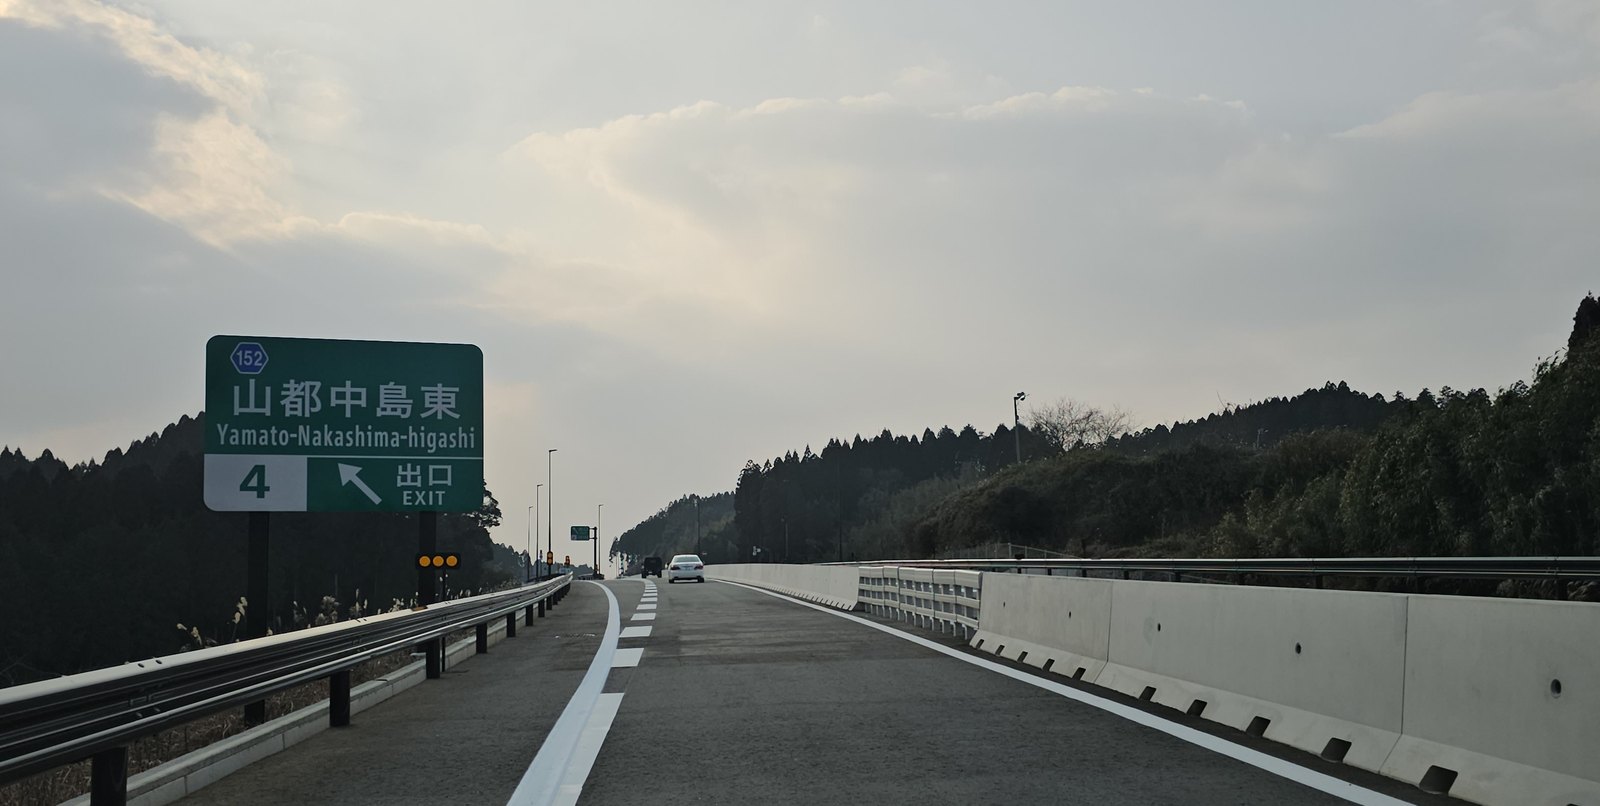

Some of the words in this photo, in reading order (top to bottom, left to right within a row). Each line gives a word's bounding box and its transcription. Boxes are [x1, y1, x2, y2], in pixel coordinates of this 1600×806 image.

[236, 351, 263, 367] 152
[233, 378, 461, 420] 山都中島東
[217, 423, 475, 453] Yamato-Nakashima-higashi
[239, 464, 270, 499] 4
[397, 463, 452, 487] 出口
[403, 491, 446, 506] EXIT
